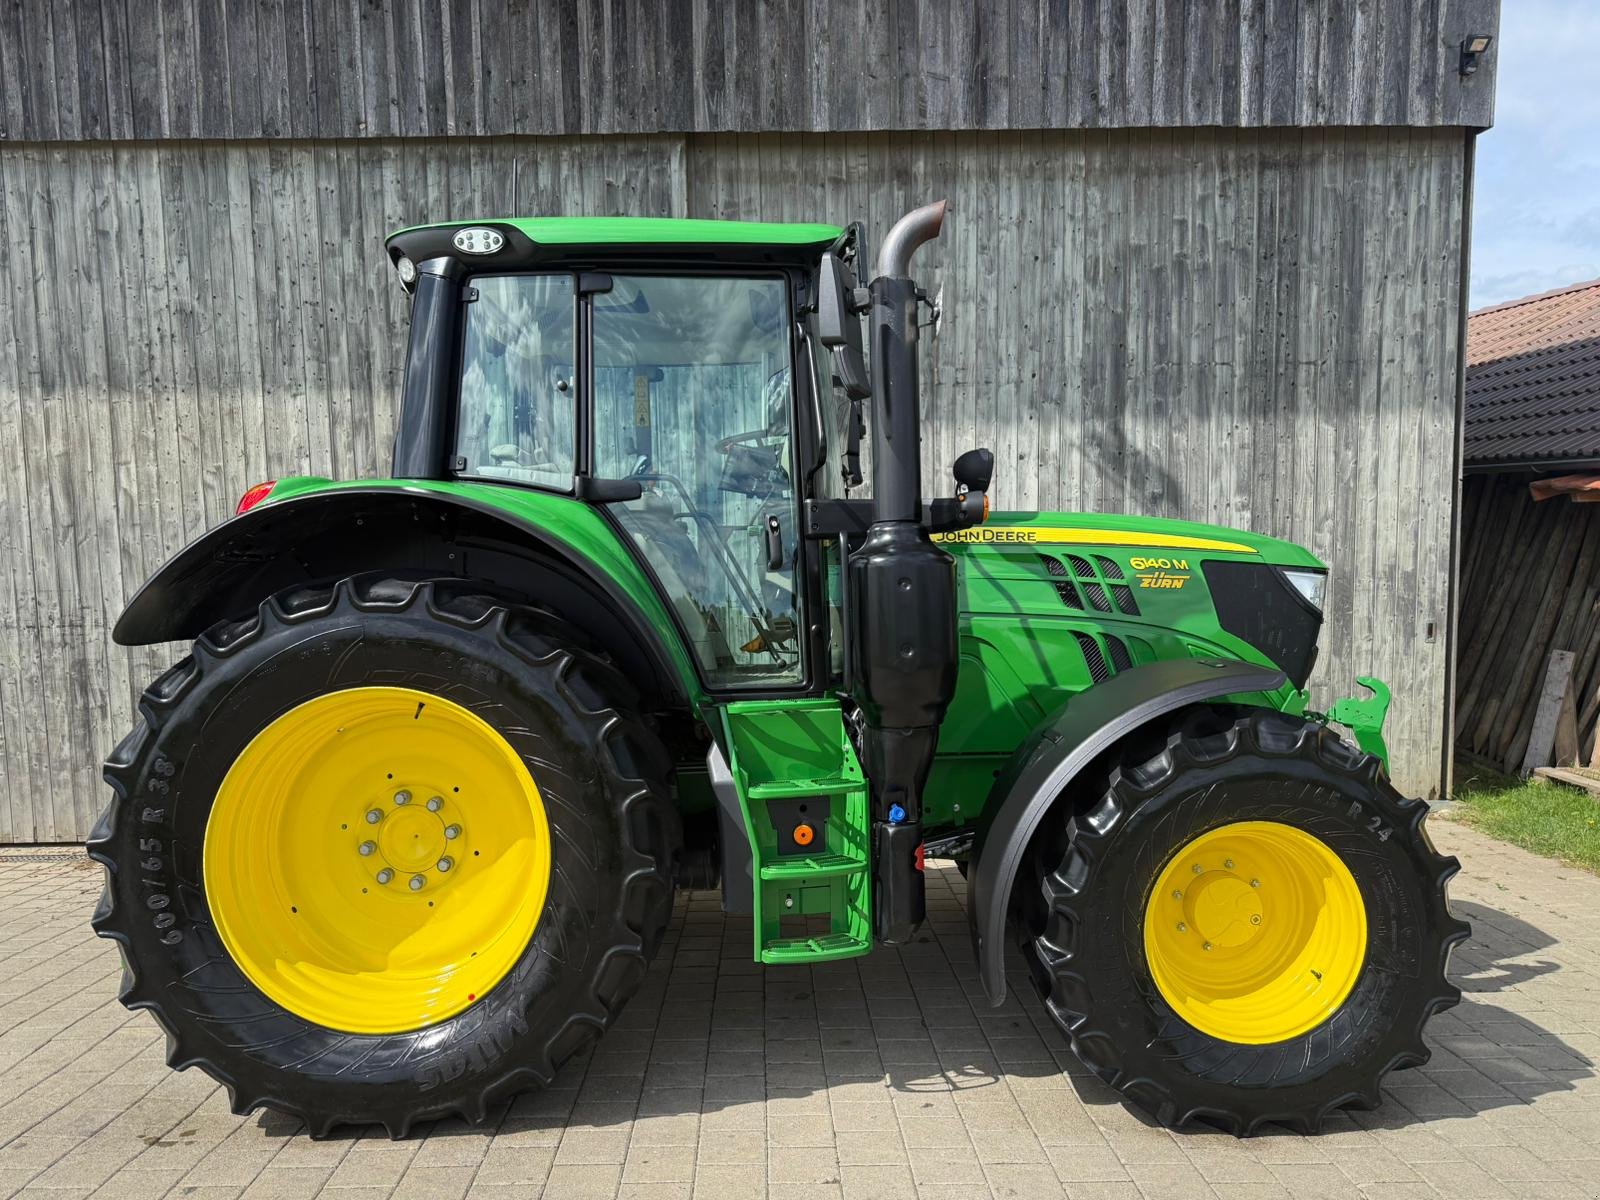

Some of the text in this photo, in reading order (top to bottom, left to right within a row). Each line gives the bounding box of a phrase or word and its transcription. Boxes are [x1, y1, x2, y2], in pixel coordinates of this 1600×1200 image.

[936, 528, 1037, 542] JOHN DEERE
[1129, 557, 1190, 571] 6140 M
[1139, 571, 1184, 588] ZÜRN
[1346, 800, 1363, 819] R
[1366, 815, 1394, 843] 24
[140, 757, 184, 946] 600/65 R 38
